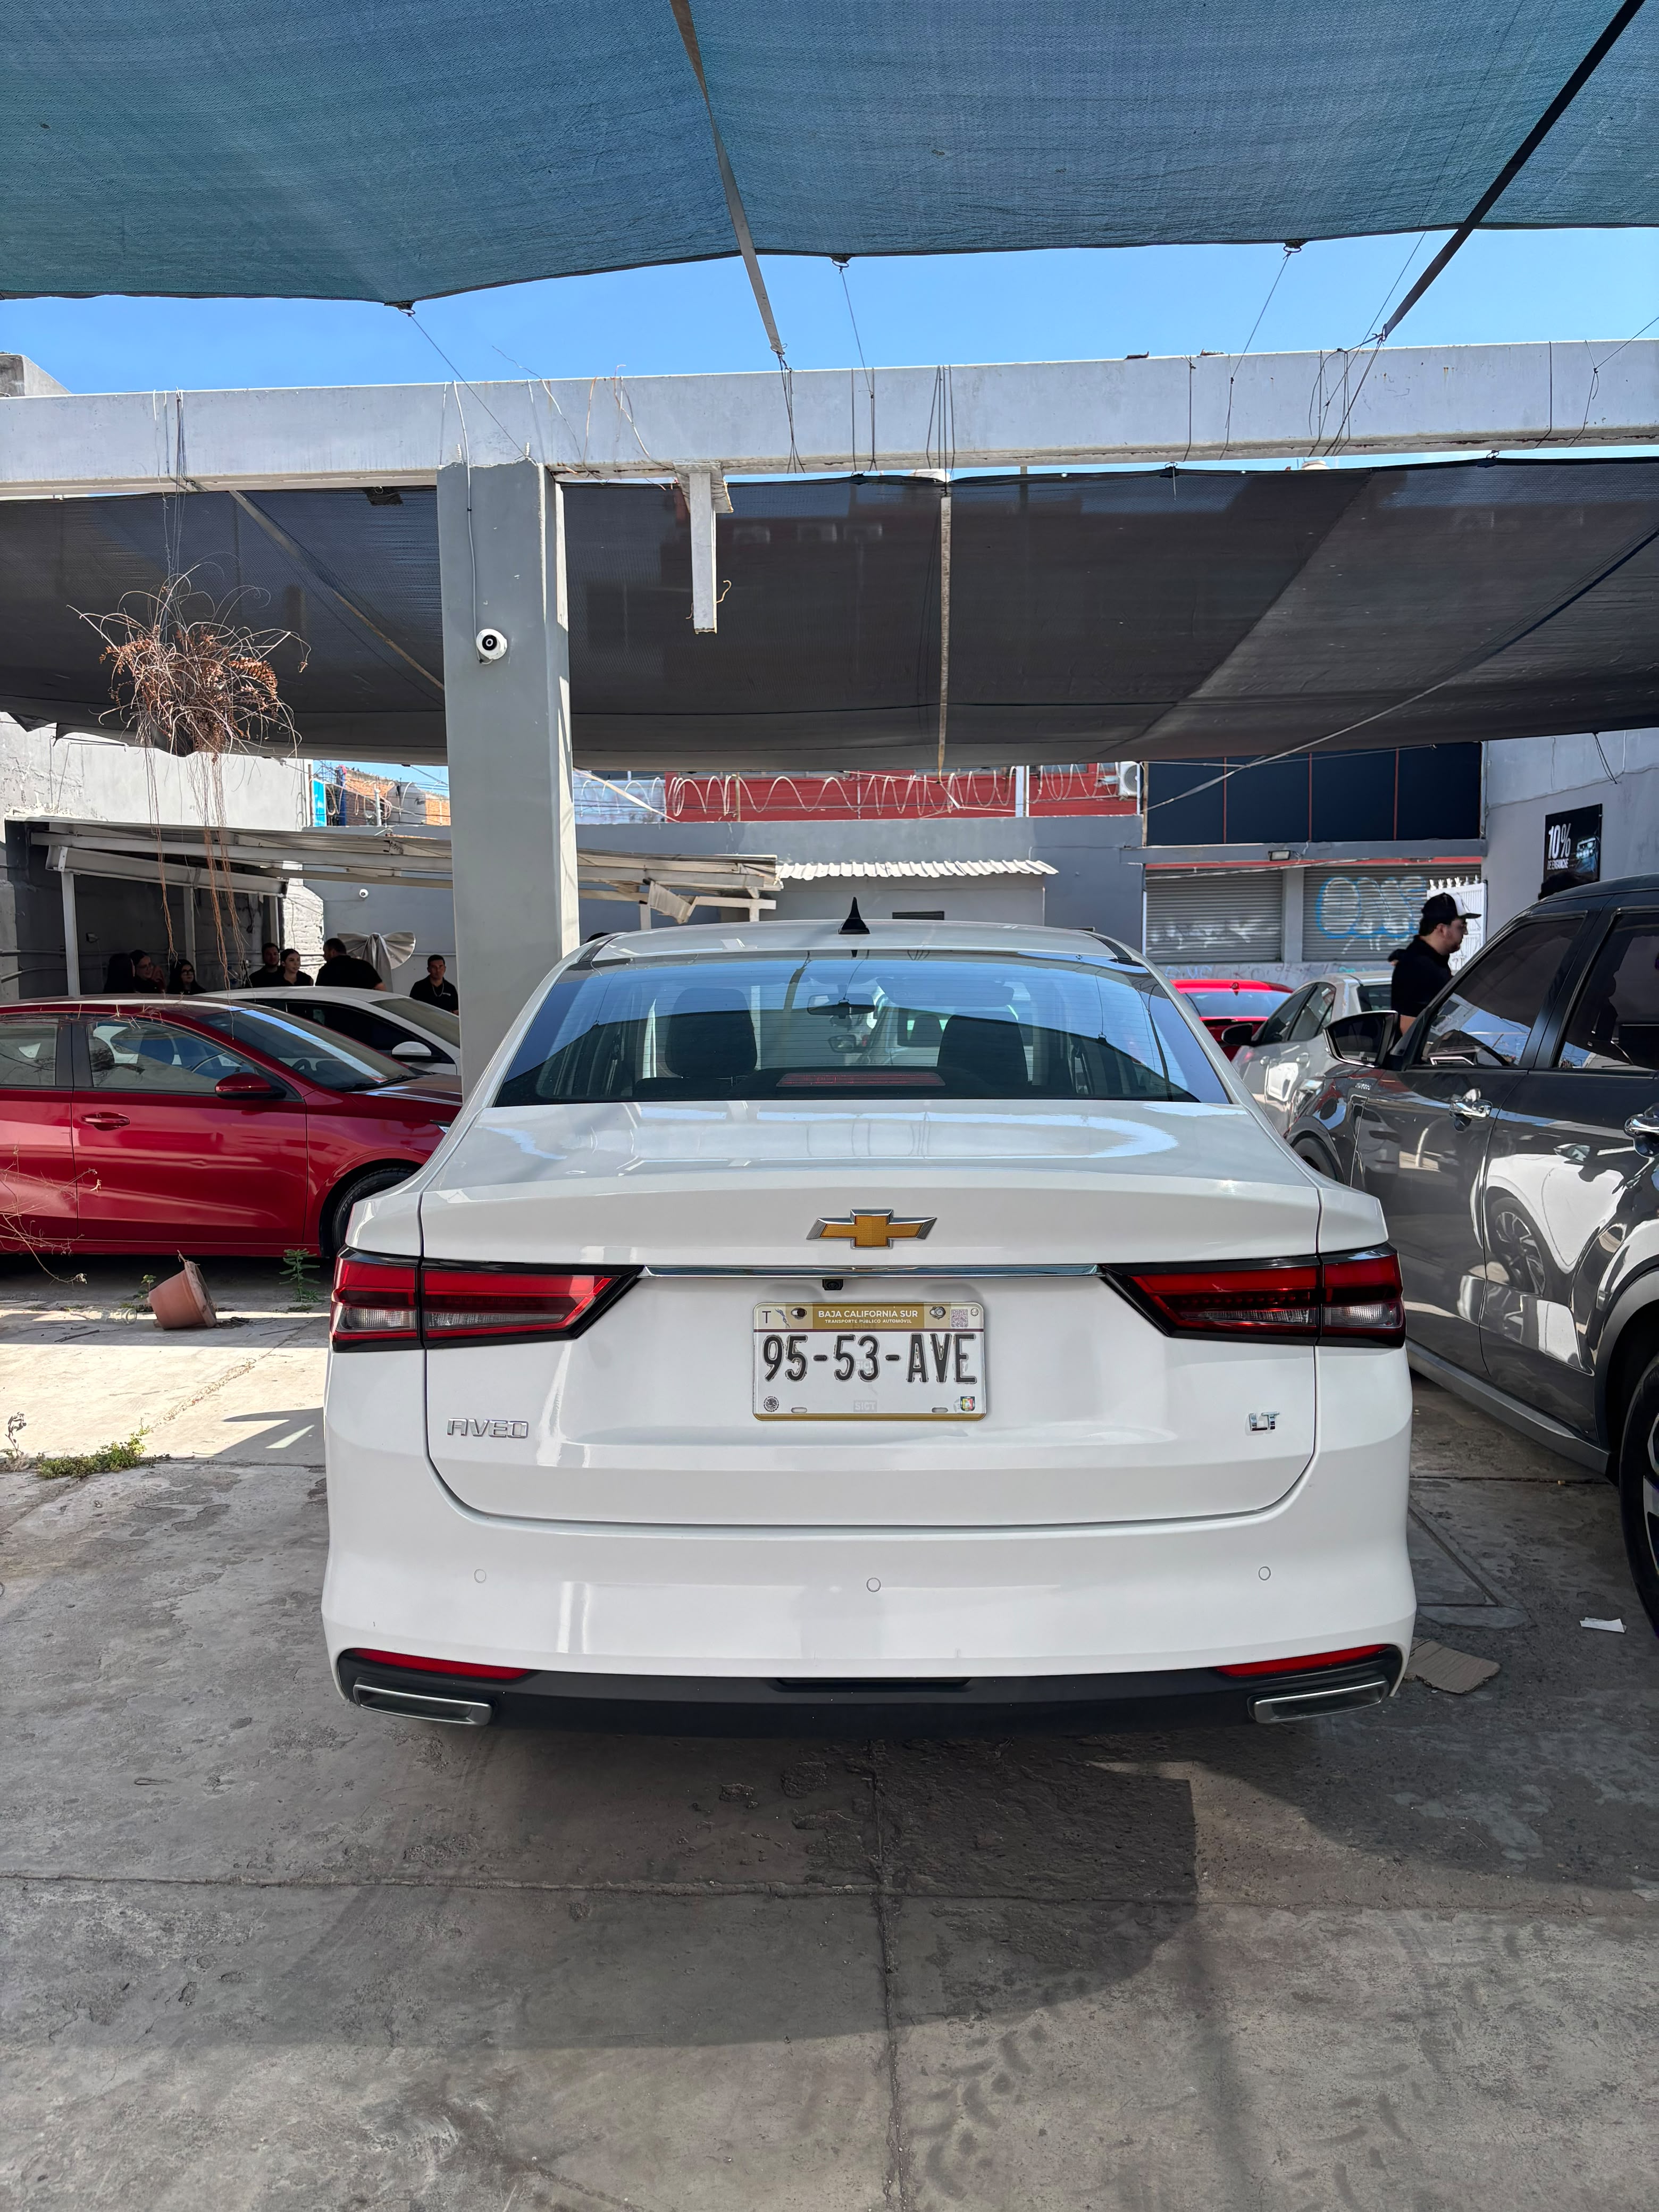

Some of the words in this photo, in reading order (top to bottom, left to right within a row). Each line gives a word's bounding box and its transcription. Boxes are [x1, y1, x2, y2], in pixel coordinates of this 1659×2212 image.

[1548, 823, 1571, 859] 10%
[762, 1311, 771, 1323] T
[763, 1333, 977, 1384] 95-53-AVE
[447, 1418, 529, 1439] AVEO
[1249, 1412, 1280, 1431] LT
